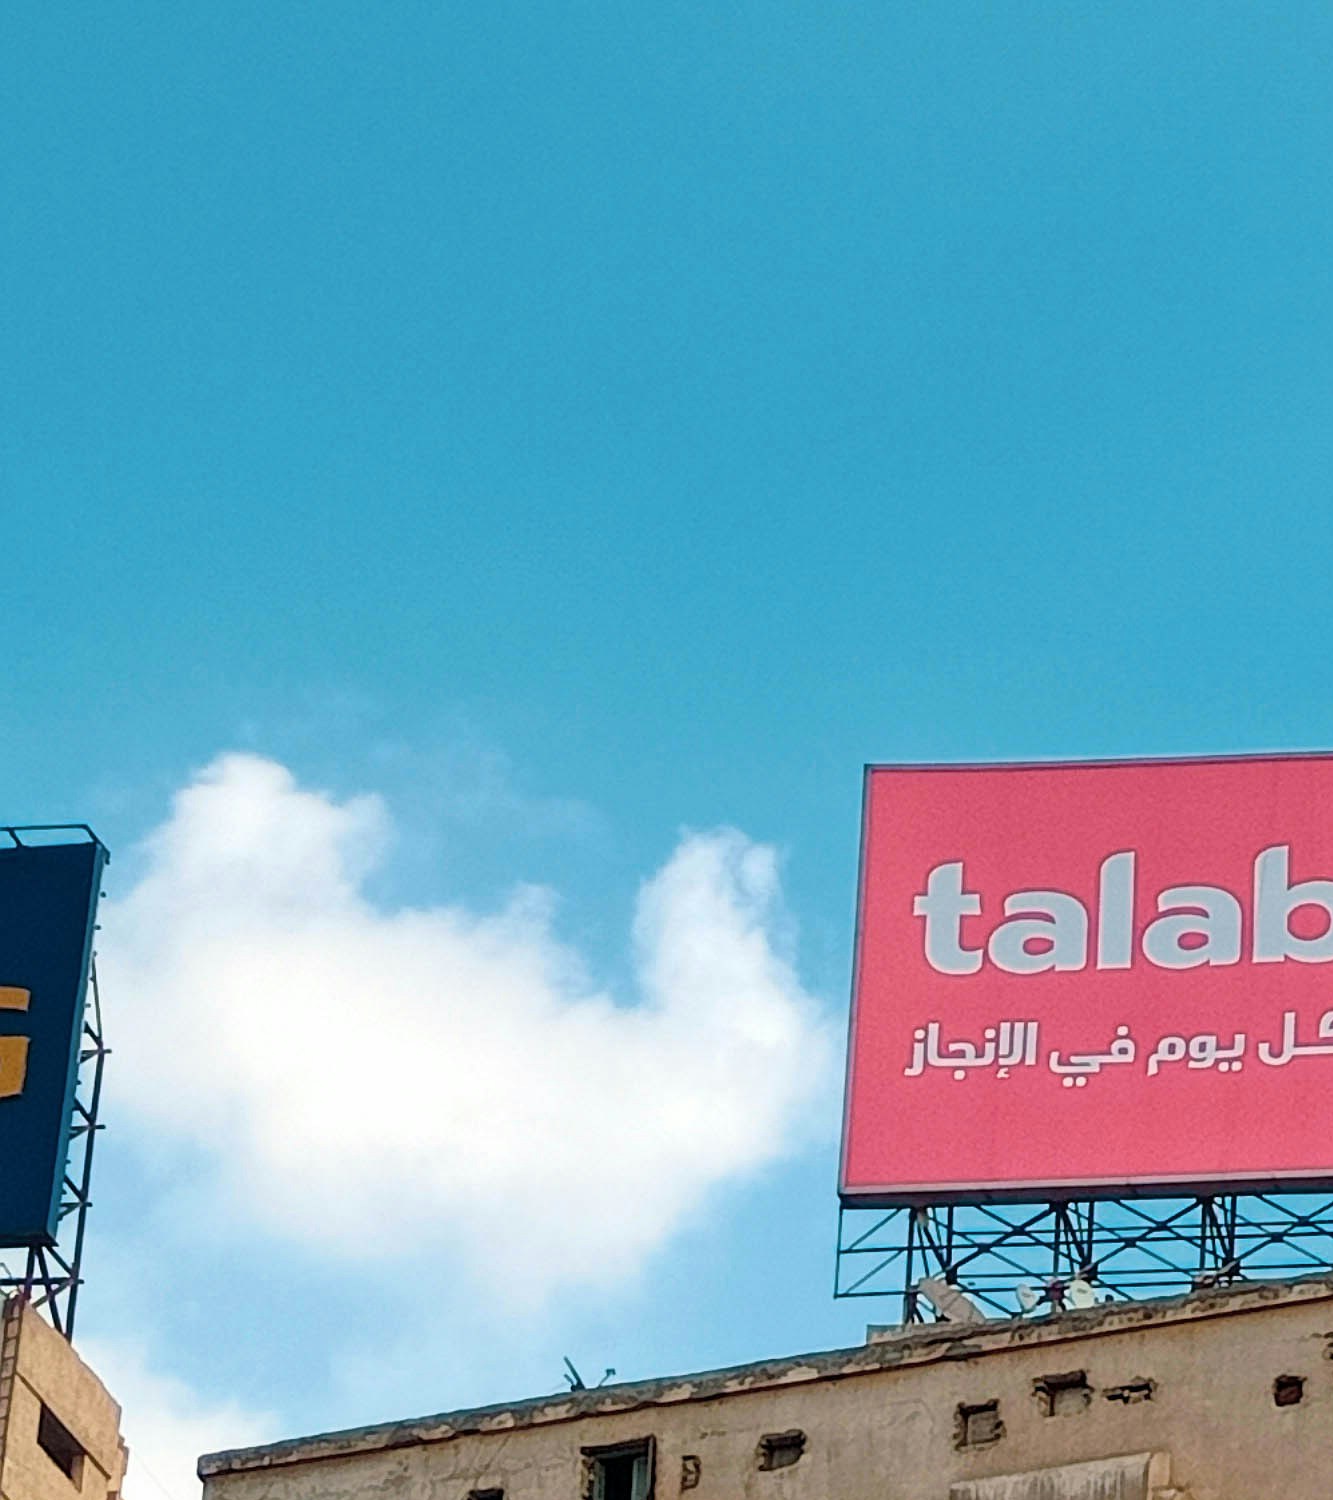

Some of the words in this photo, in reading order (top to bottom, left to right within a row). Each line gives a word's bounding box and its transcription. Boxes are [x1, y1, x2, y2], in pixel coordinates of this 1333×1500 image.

[904, 1020, 1038, 1079] الإنجاز
[1049, 1025, 1135, 1086] في
[1147, 1033, 1245, 1075] يوم
